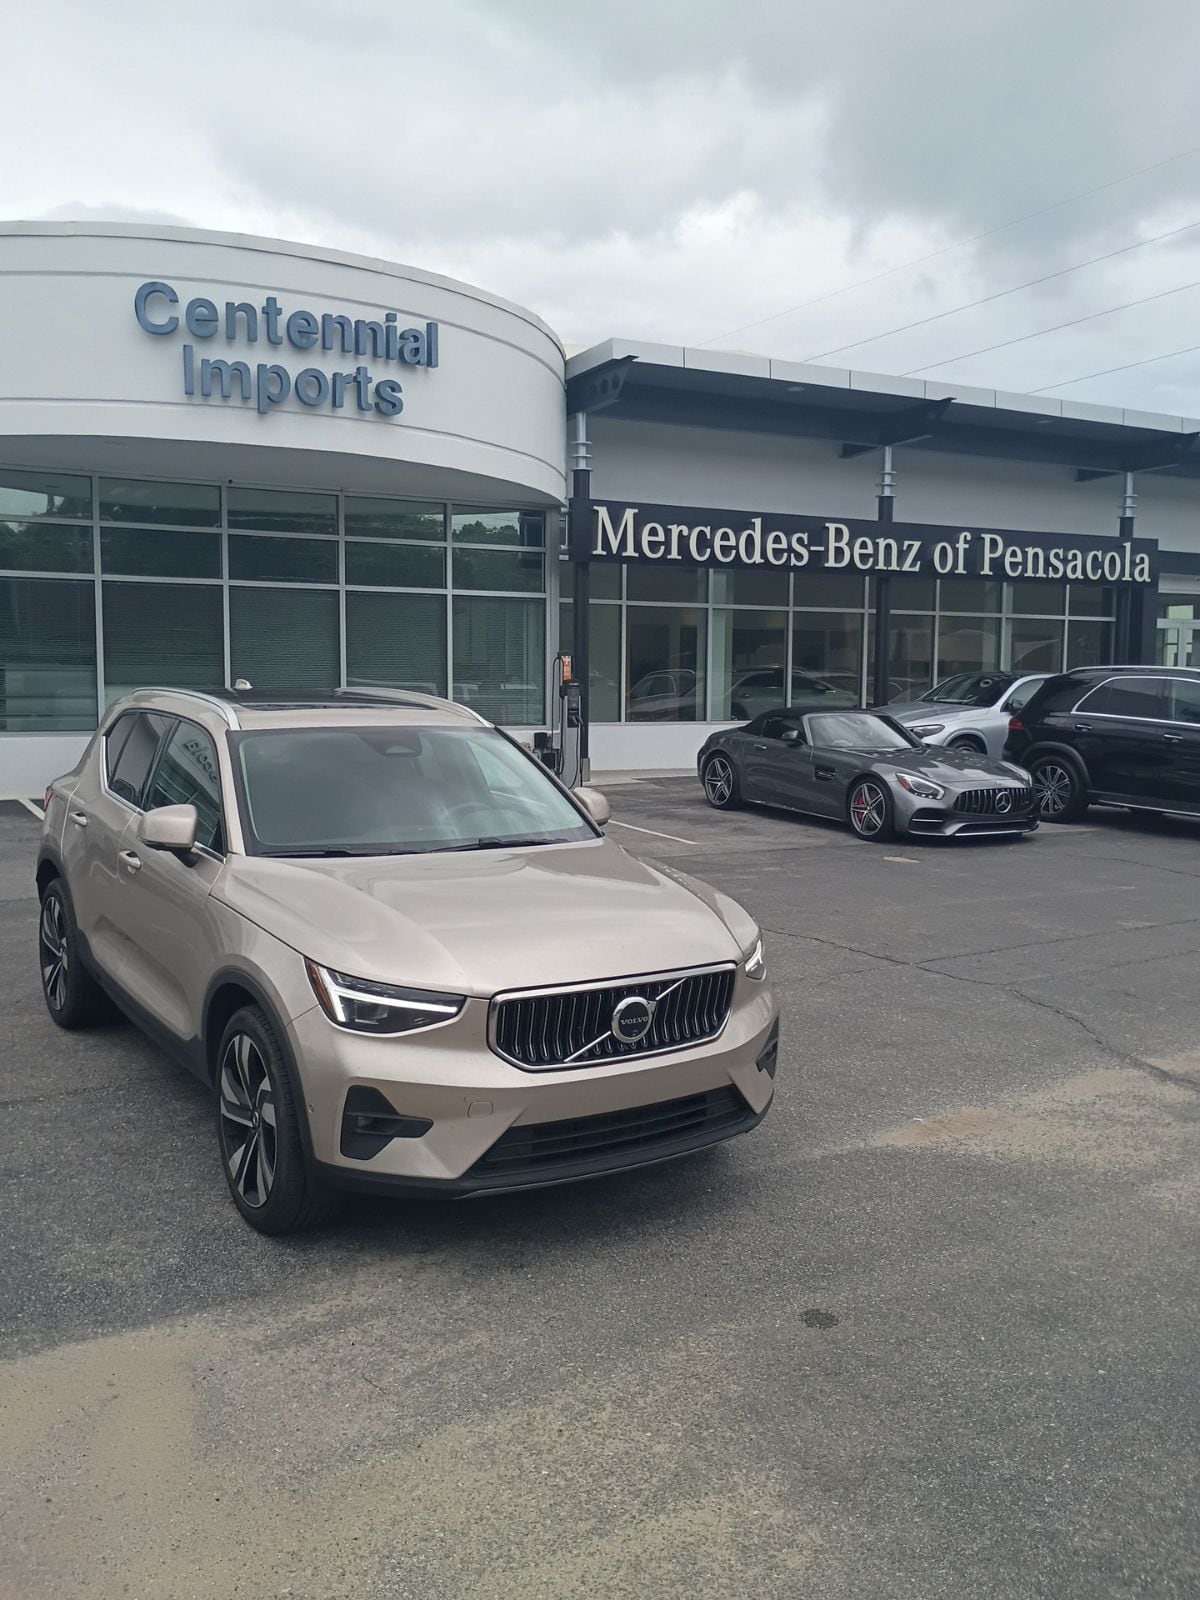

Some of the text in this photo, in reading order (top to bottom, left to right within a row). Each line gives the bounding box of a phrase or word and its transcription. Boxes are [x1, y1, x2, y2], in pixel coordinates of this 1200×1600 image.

[134, 281, 439, 368] Centennial
[183, 344, 404, 416] Imports
[592, 505, 1151, 583] Mercedes-Benz of Pensacola
[620, 1016, 648, 1025] VOLVO
